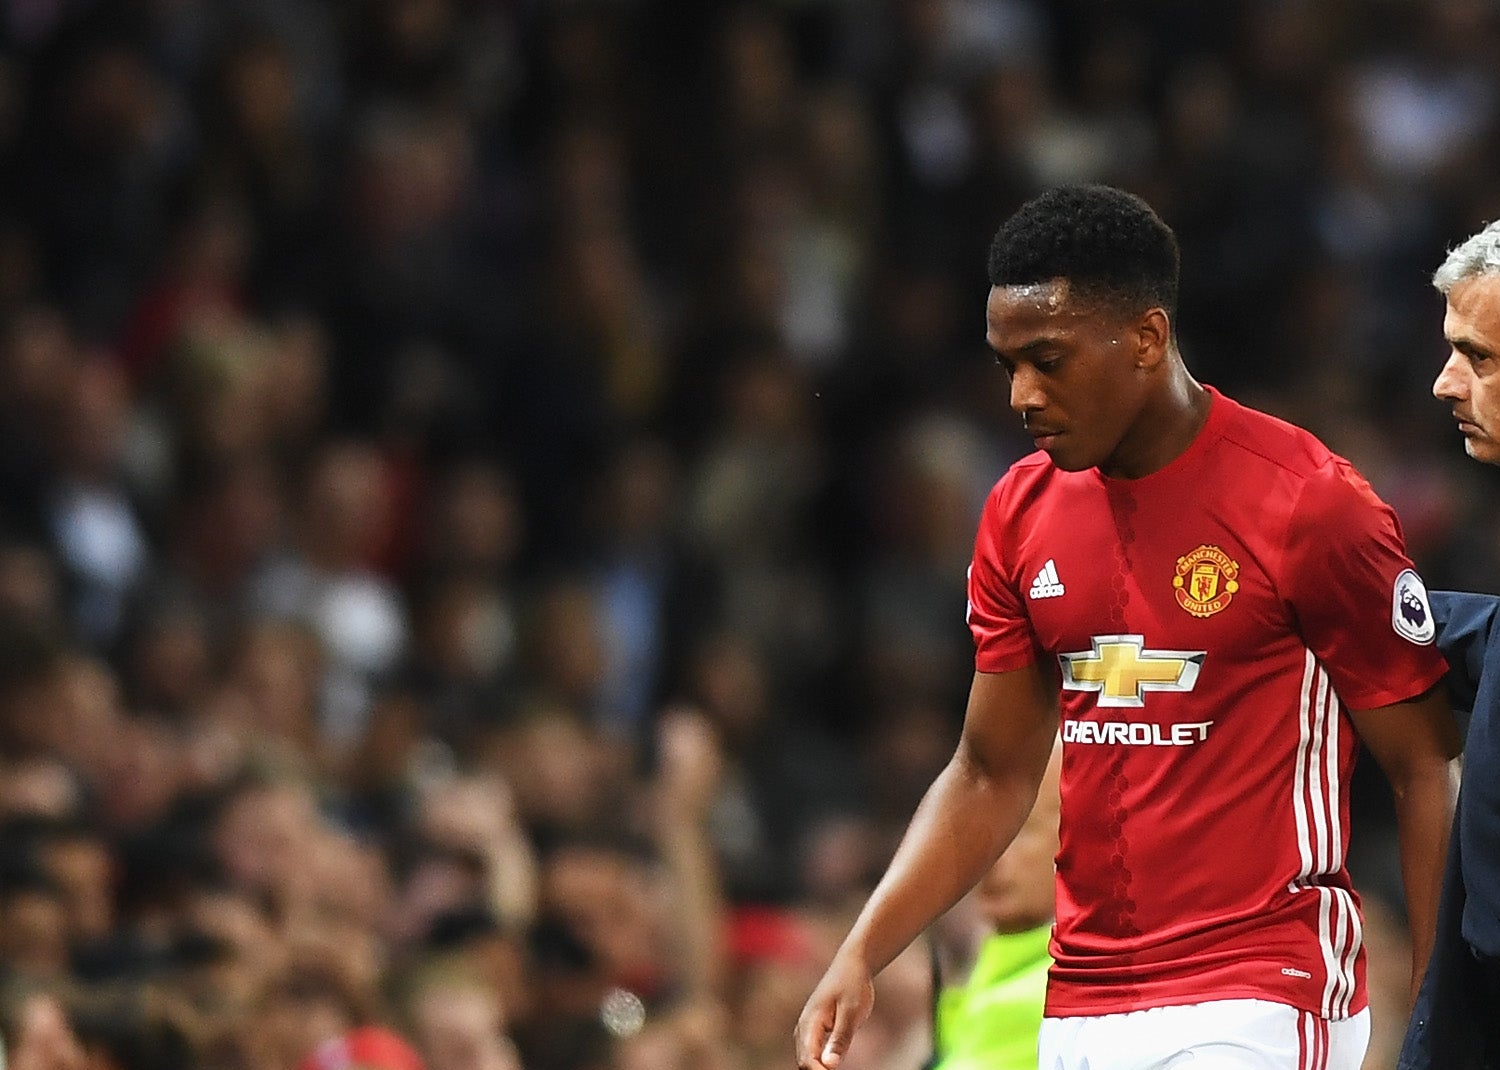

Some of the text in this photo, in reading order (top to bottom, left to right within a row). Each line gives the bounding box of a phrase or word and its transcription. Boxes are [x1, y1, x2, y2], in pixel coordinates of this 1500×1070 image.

[1180, 550, 1234, 577] MANCHESTER
[1030, 584, 1065, 599] adidas
[1183, 598, 1221, 613] UNITED
[1063, 720, 1214, 746] CHEVROLET
